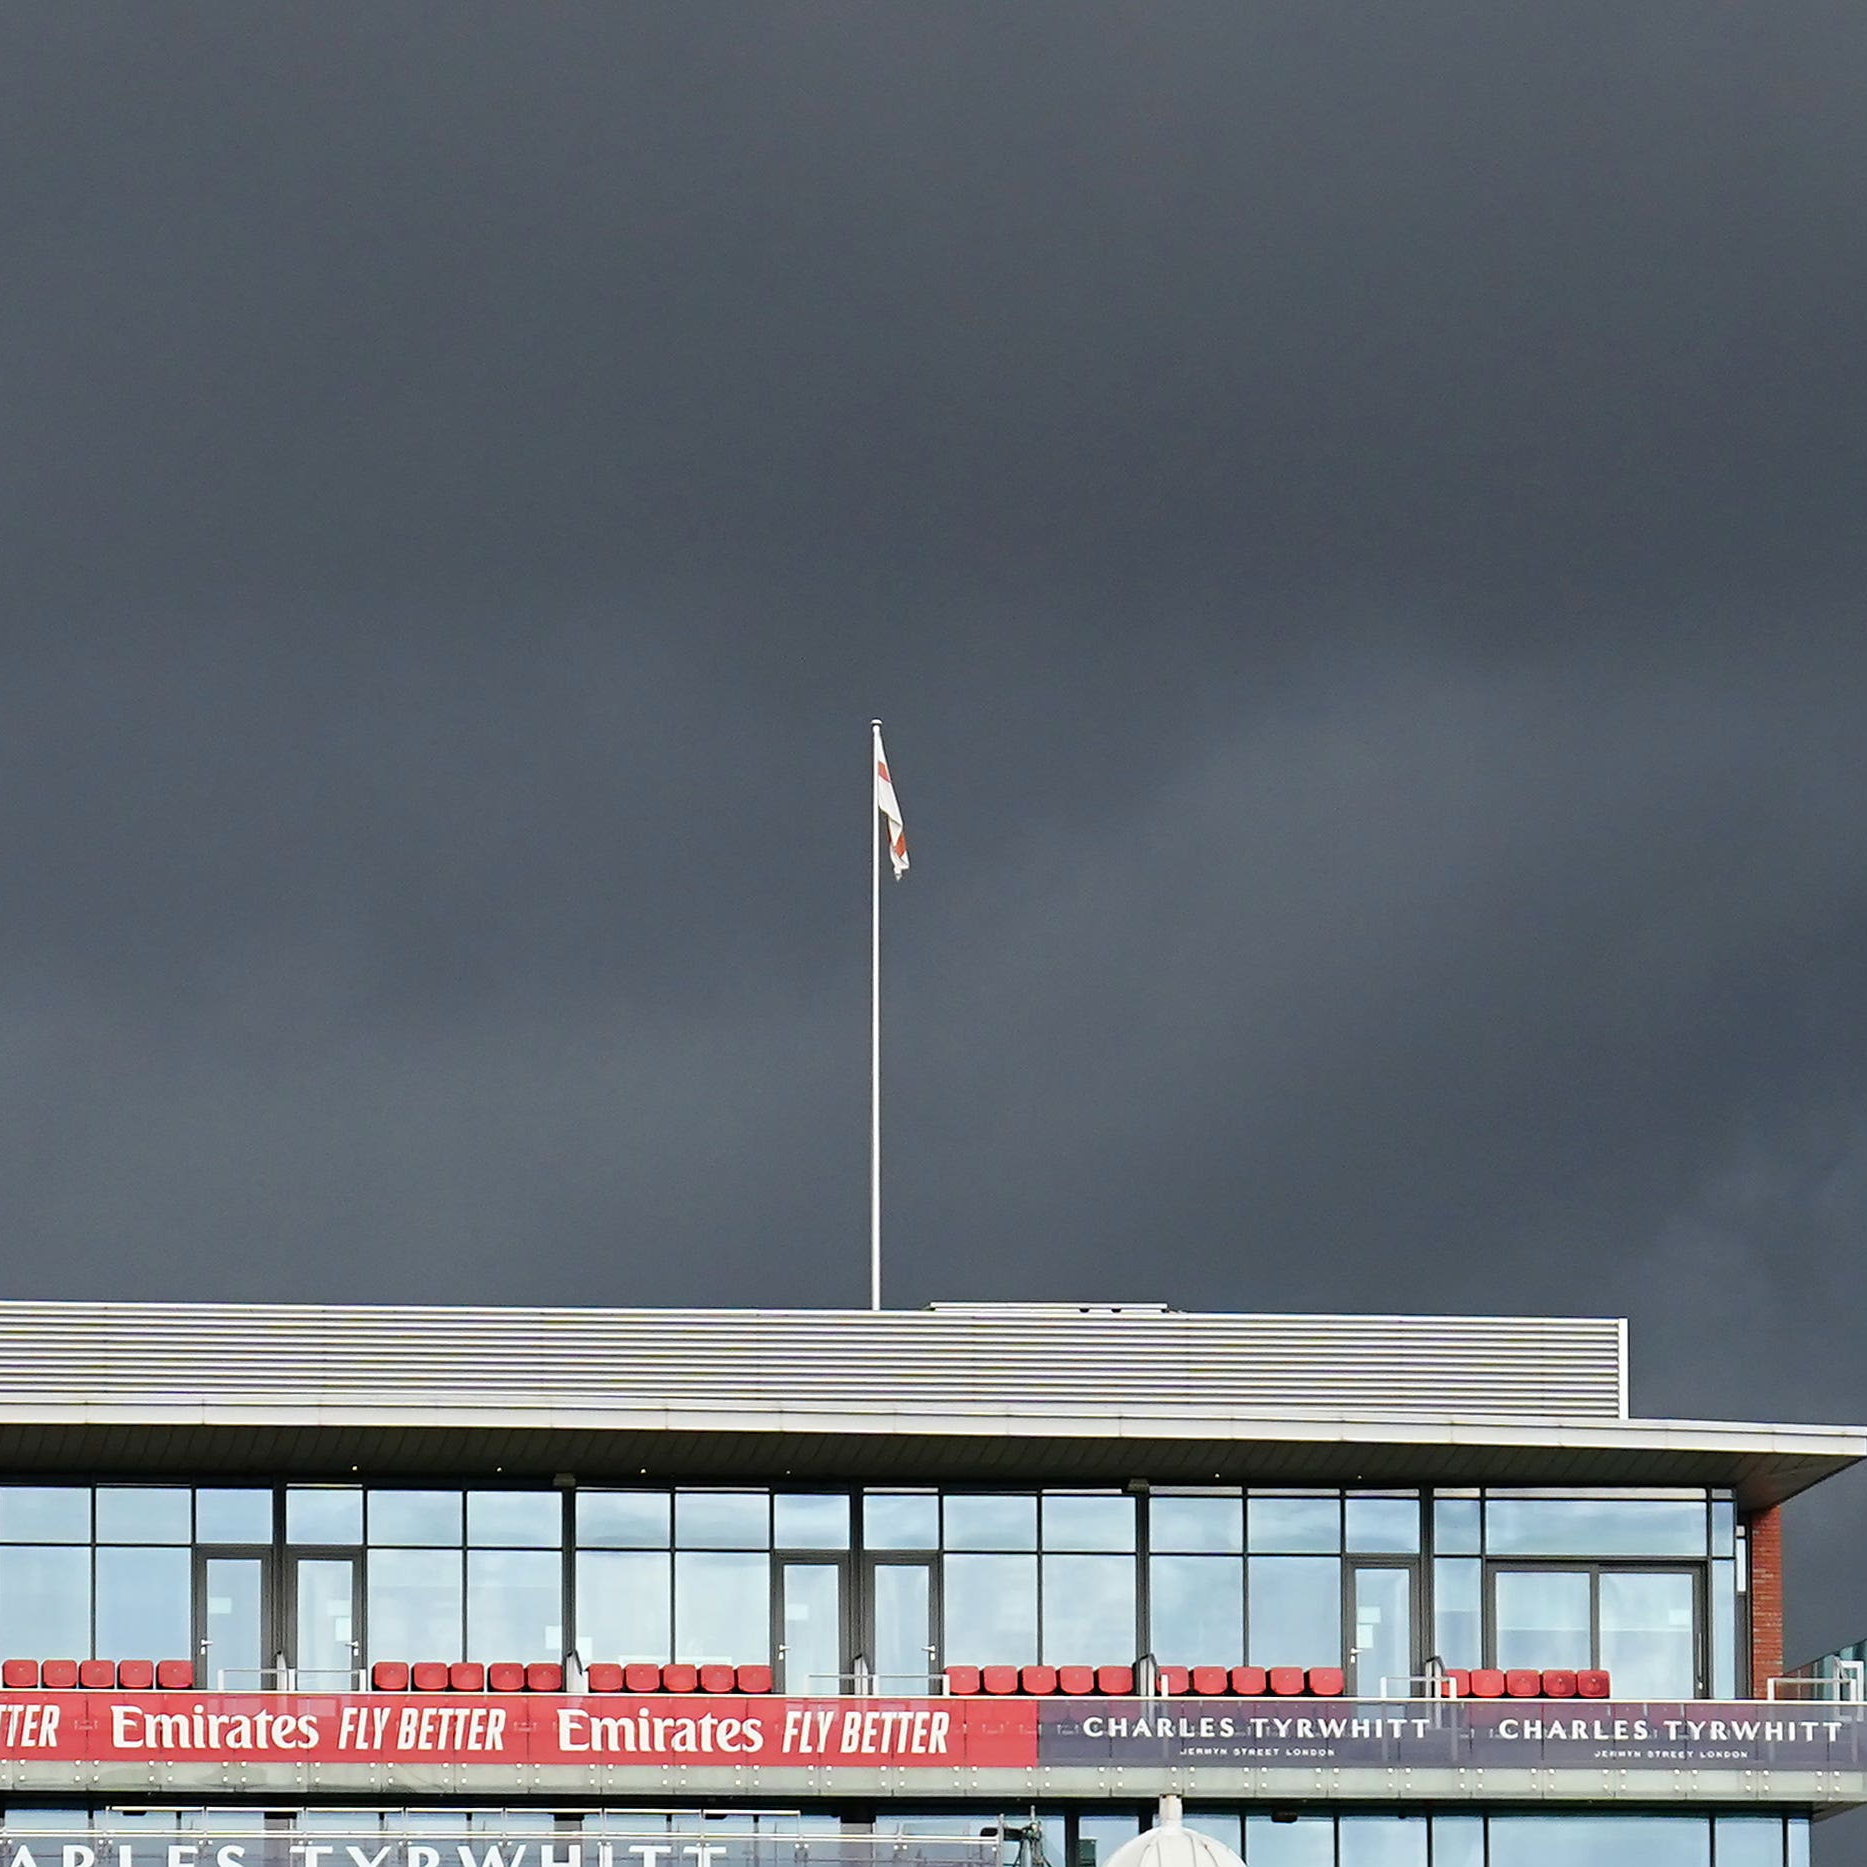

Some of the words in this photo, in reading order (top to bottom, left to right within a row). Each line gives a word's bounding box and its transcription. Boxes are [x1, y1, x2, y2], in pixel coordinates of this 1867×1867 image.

[110, 1704, 320, 1750] Emirates
[337, 1705, 392, 1749] FLY
[396, 1707, 506, 1751] BETTER
[557, 1706, 765, 1753] Emirates
[781, 1709, 837, 1753] FLY
[840, 1710, 949, 1755] BETTER
[1082, 1717, 1235, 1739] CHARLES
[1250, 1718, 1431, 1739] TYRWHITT
[1498, 1719, 1649, 1741] CHARLES
[1663, 1720, 1843, 1742] TYRWHITT
[1233, 1748, 1280, 1756] STREET
[1286, 1749, 1335, 1757] LONDON
[1699, 1751, 1749, 1759] LONDON
